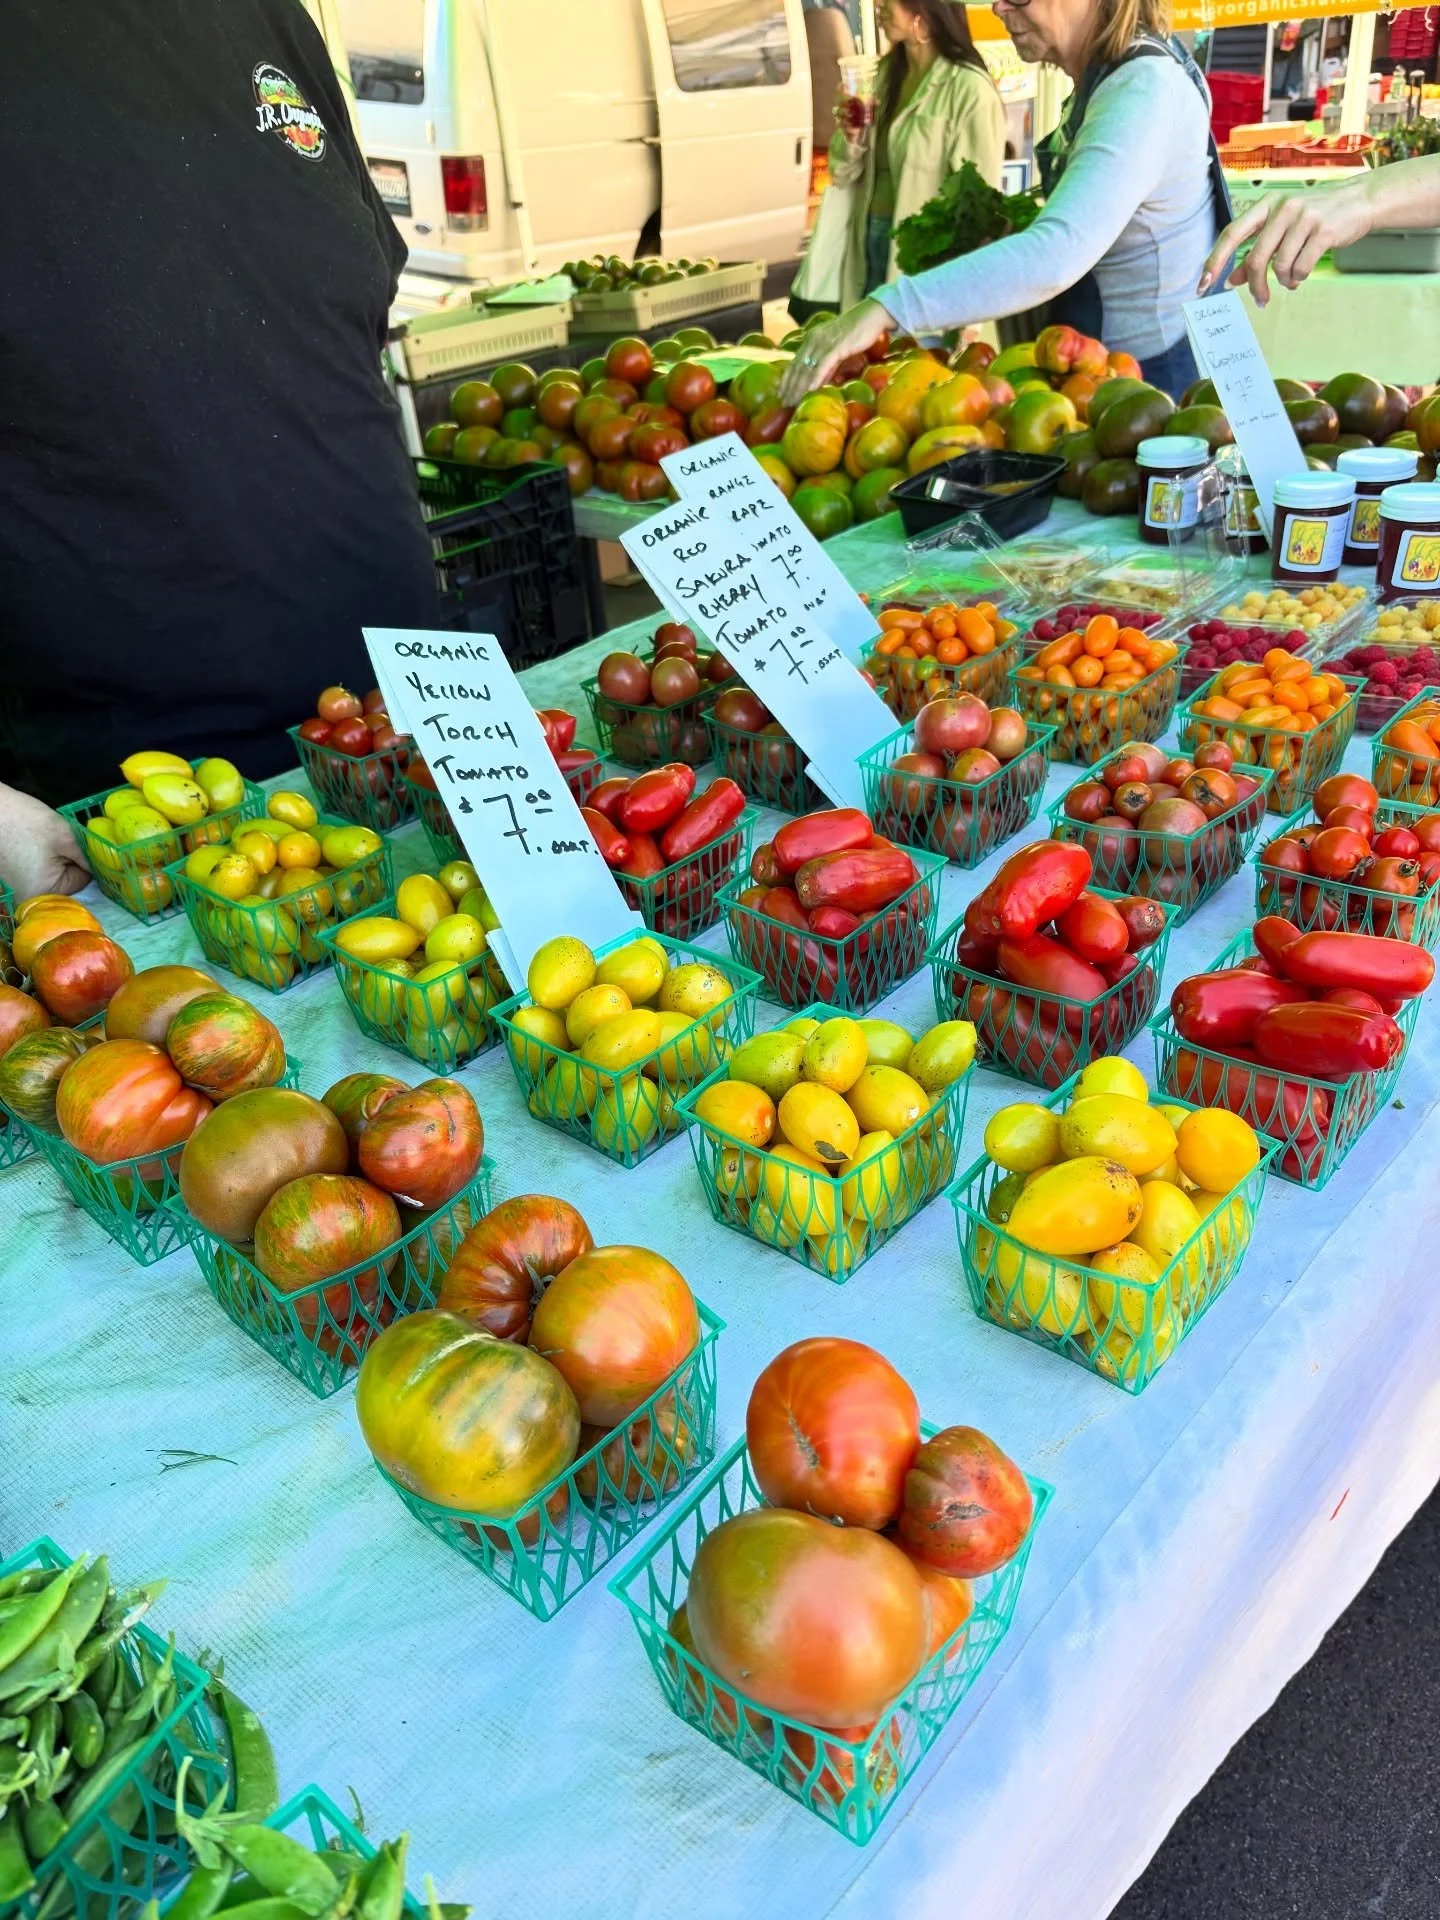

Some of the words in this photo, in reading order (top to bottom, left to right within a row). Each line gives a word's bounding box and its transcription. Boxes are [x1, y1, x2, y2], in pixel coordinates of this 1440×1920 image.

[680, 447, 737, 476] ORGANIC
[709, 475, 756, 499] RANGE
[732, 499, 774, 522] RAPE
[641, 506, 710, 547] ORGANIC
[676, 554, 751, 598] SAKURA
[715, 606, 787, 652] TOMATO
[394, 641, 490, 661] ORGANIC
[405, 671, 491, 702] YELLOW
[422, 714, 519, 748] TORCH
[433, 755, 529, 784] TOMATO
